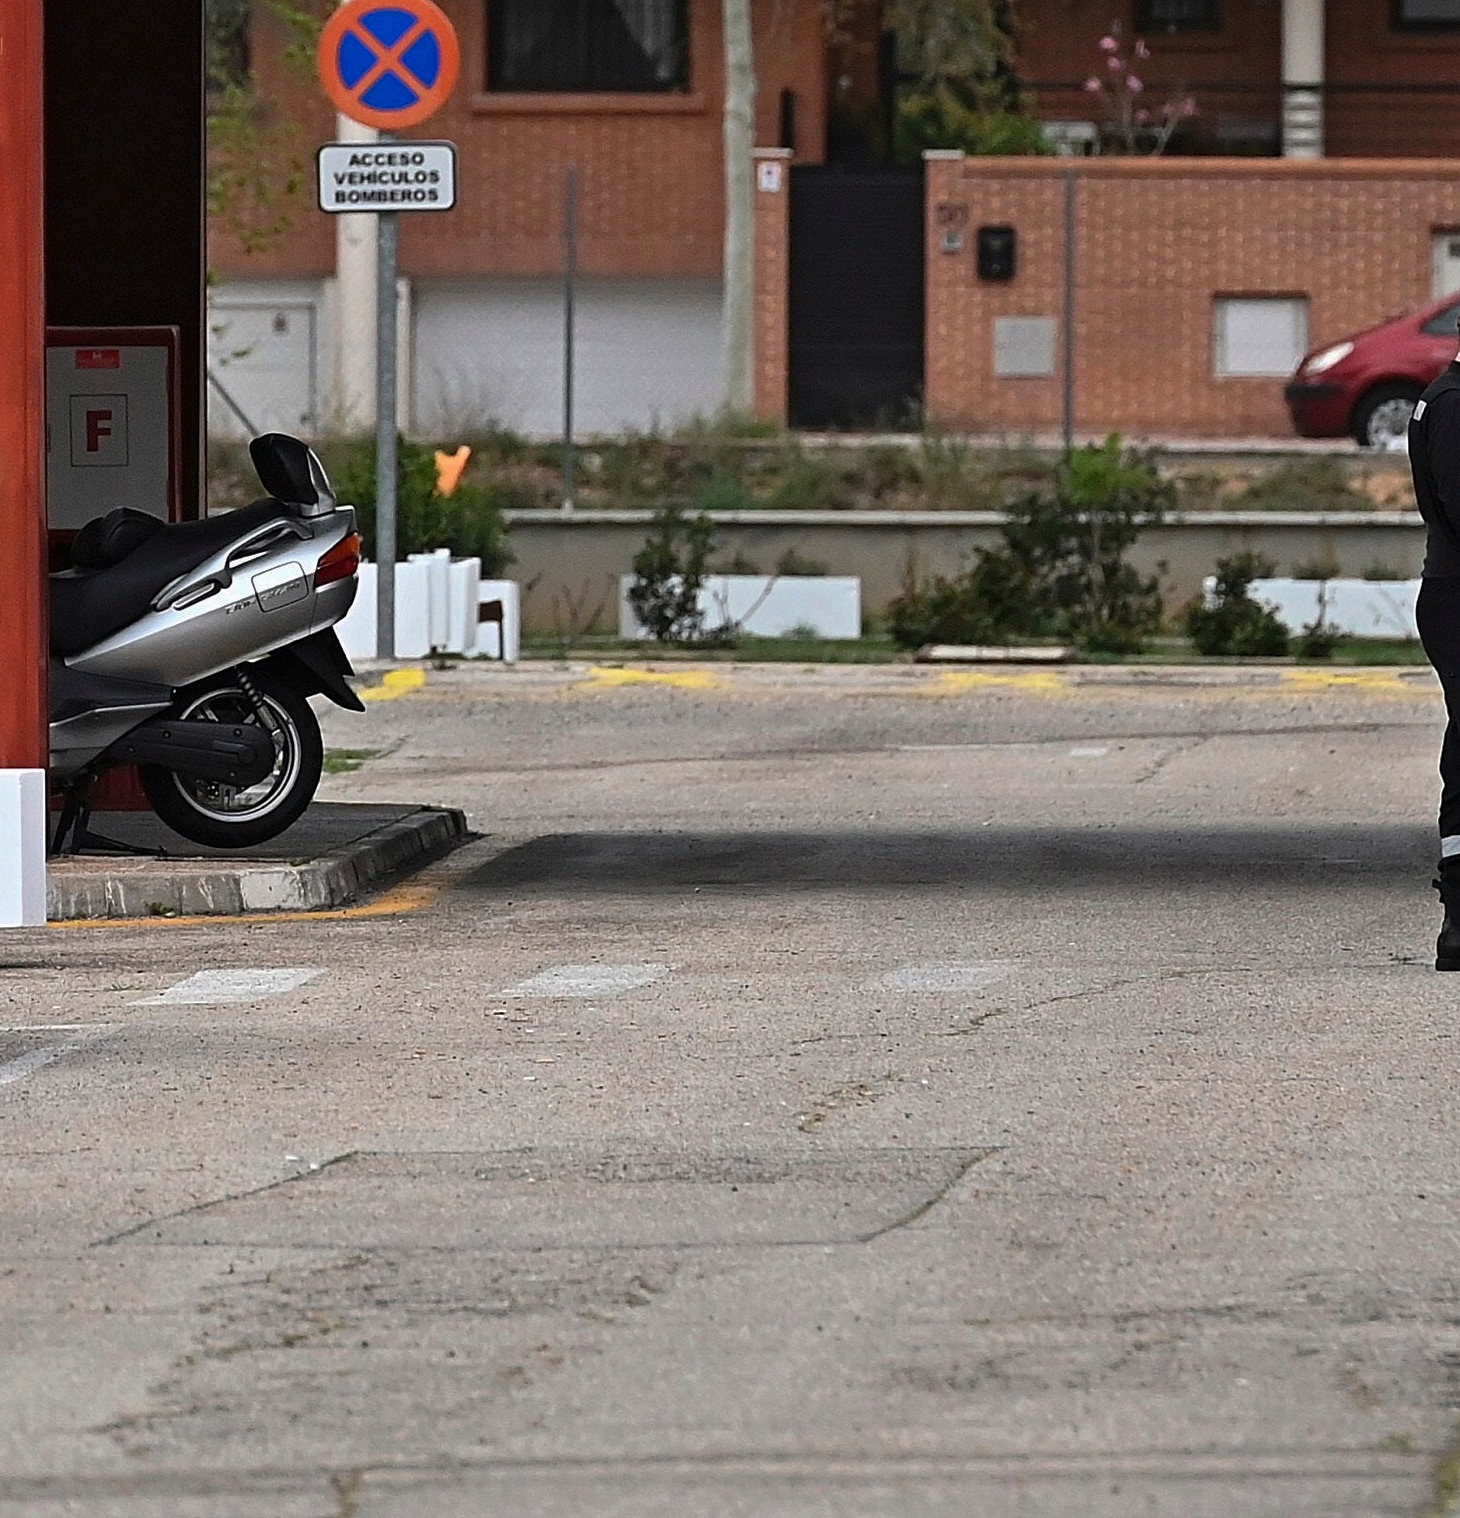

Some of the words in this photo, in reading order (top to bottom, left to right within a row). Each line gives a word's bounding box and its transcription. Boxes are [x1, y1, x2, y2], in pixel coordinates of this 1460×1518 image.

[349, 153, 424, 166] ACCESO
[334, 170, 440, 184] VEHÍCULOS
[335, 189, 439, 203] BOMBEROS
[86, 410, 113, 452] F
